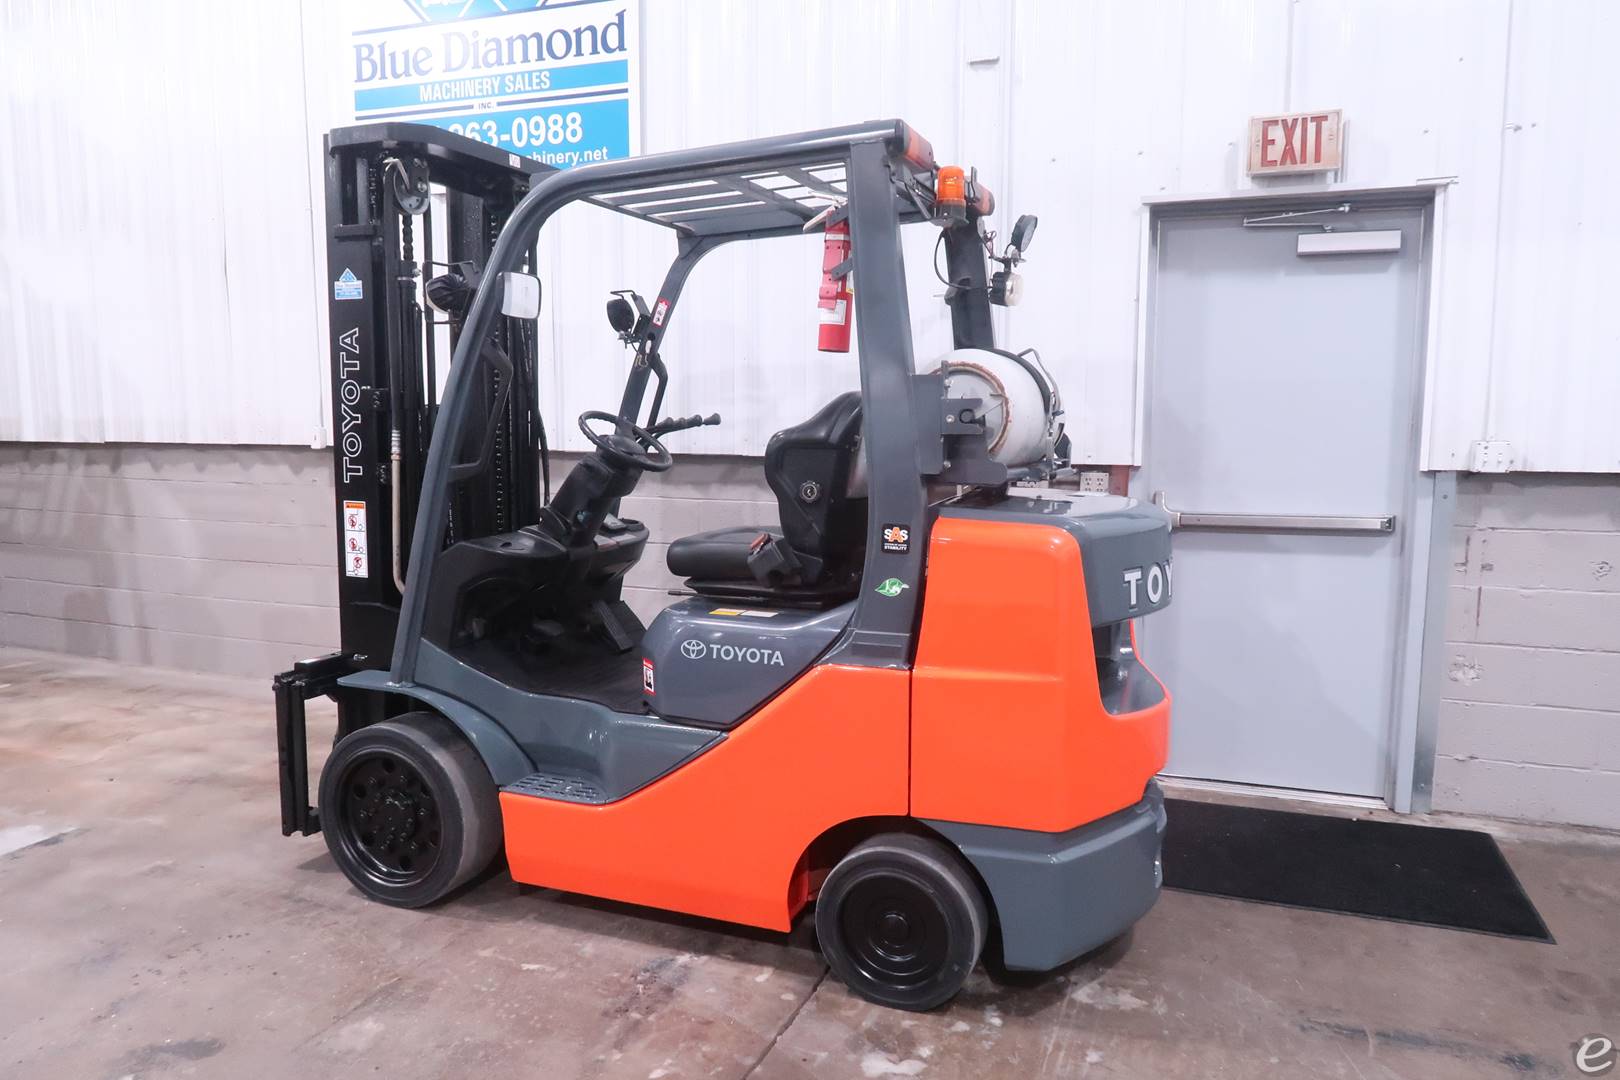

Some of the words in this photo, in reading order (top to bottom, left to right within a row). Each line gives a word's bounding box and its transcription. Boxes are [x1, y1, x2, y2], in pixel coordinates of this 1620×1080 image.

[354, 41, 433, 83] Blue
[442, 8, 627, 74] Diamond
[419, 74, 501, 103] MACHINERY
[504, 70, 551, 94] SALES
[478, 101, 495, 110] INC.
[1260, 114, 1329, 168] EXIT
[526, 145, 609, 167] hinery.net
[339, 327, 363, 484] TOYOTA
[884, 526, 909, 543] SAS
[709, 643, 785, 667] TOYOTA
